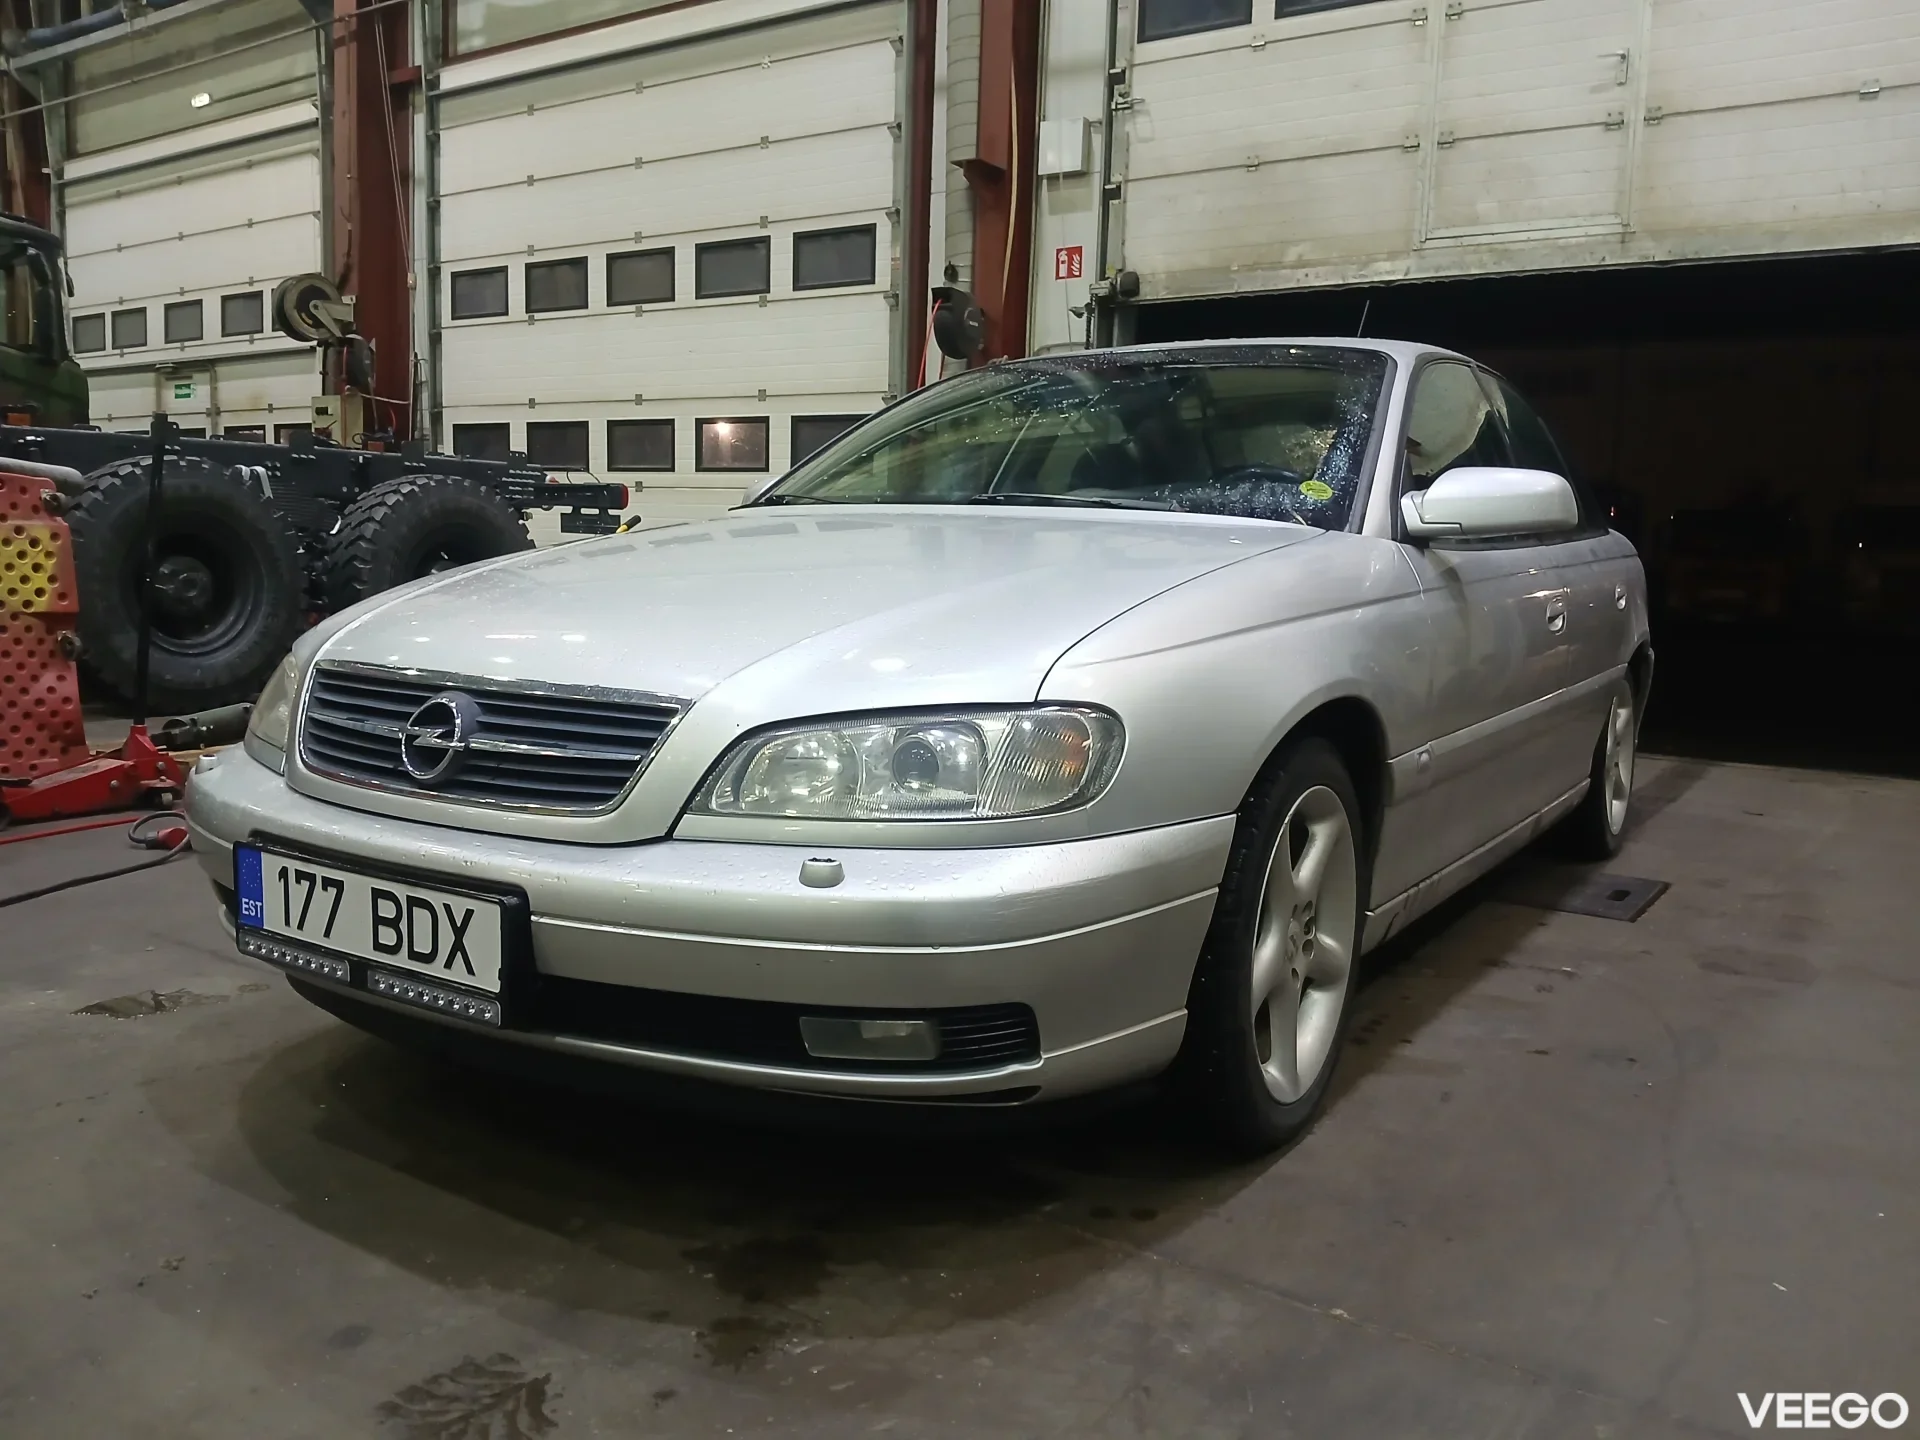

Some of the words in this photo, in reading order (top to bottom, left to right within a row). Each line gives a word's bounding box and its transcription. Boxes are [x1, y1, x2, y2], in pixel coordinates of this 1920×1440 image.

[242, 898, 263, 918] EST
[278, 866, 345, 938] 177
[370, 886, 476, 976] BDX
